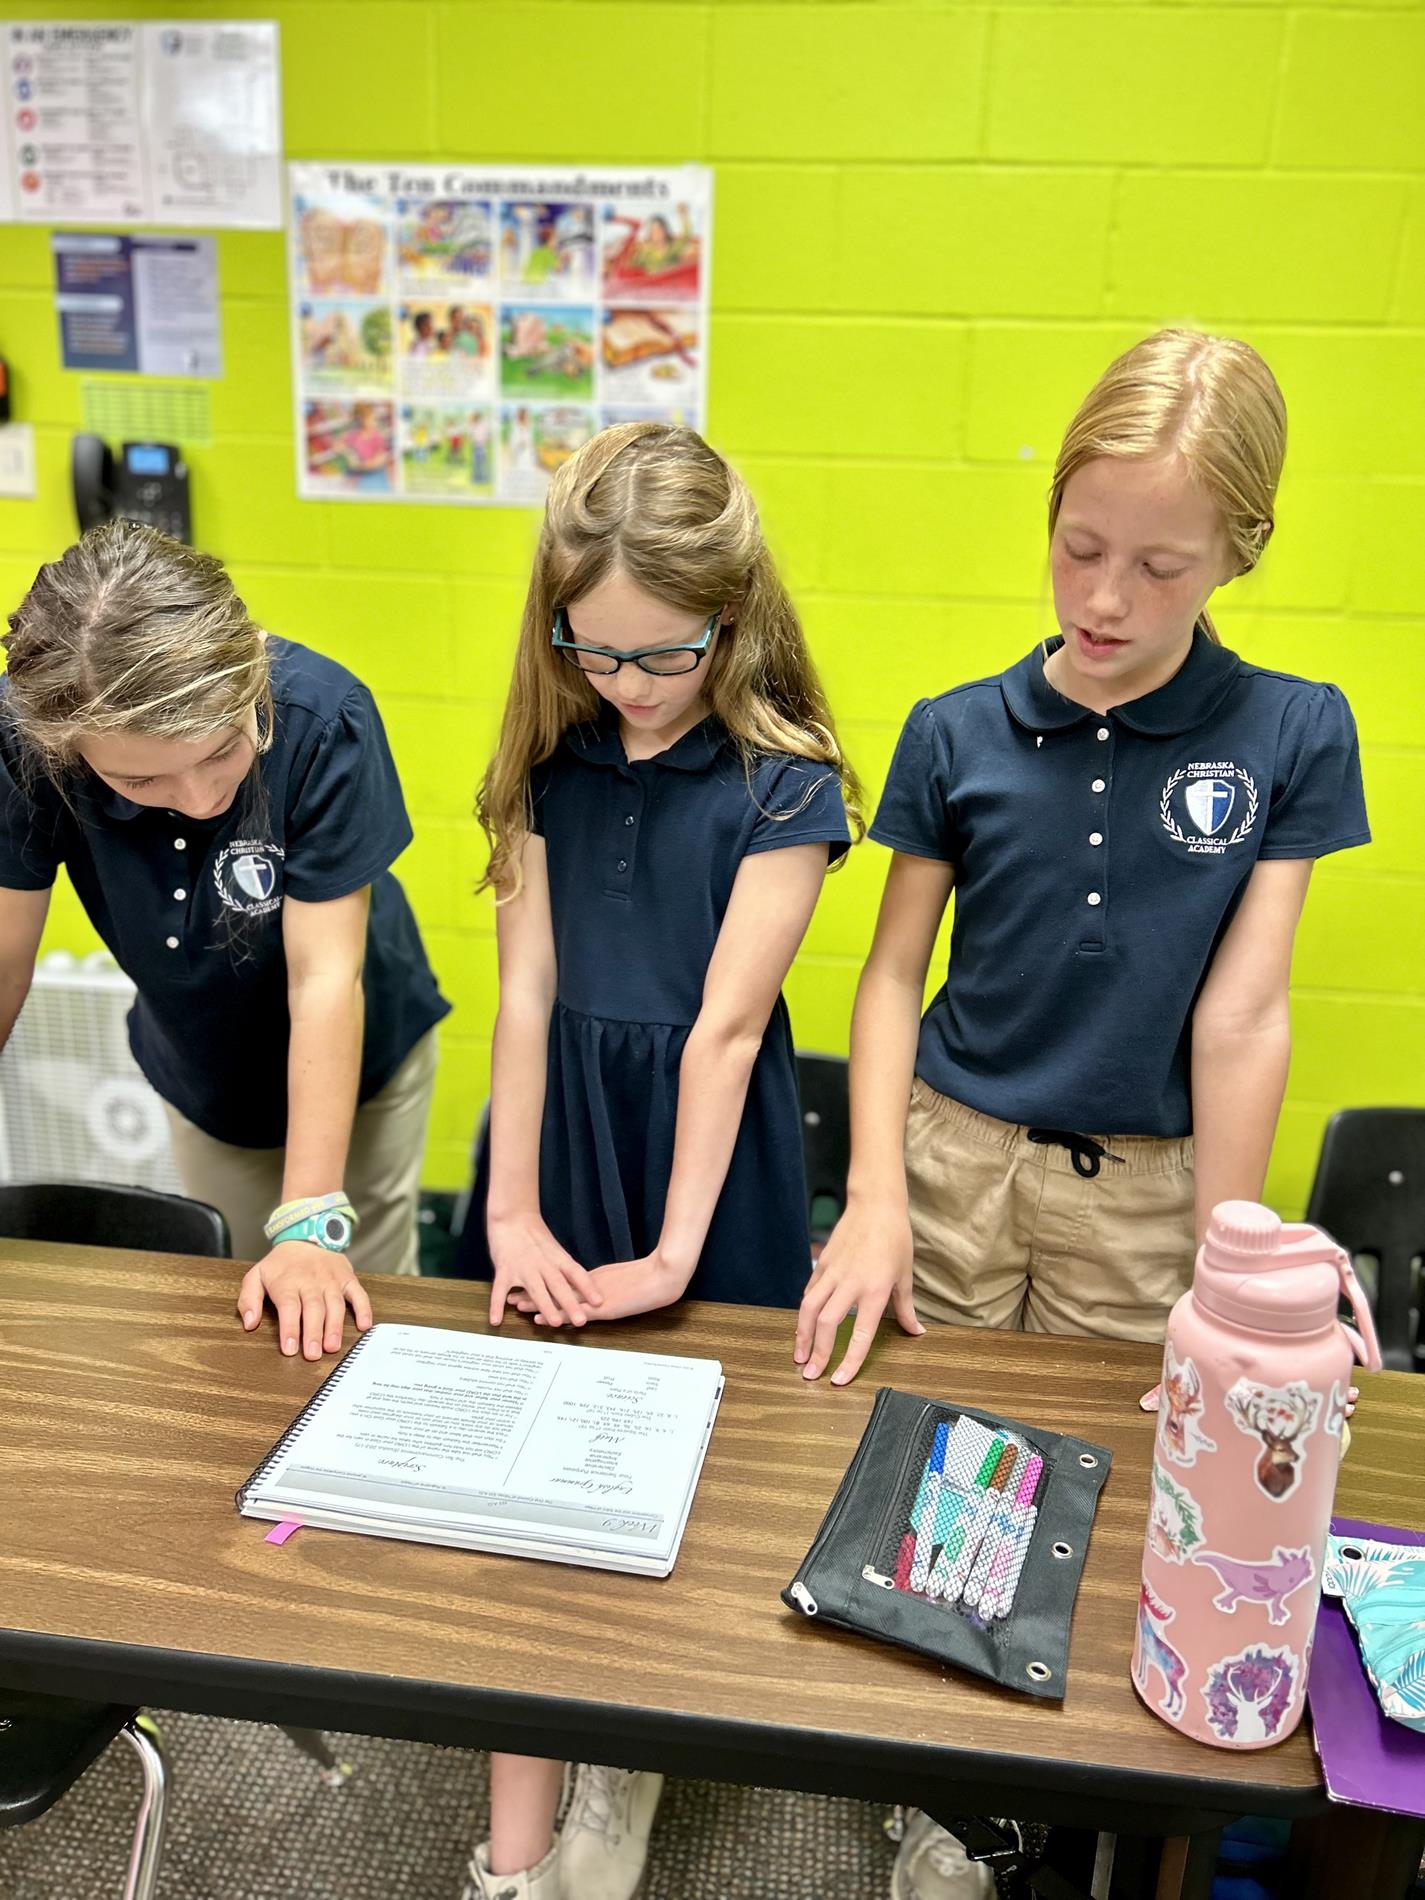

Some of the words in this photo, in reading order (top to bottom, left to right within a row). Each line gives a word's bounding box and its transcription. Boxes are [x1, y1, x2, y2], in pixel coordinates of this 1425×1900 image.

[328, 171, 374, 193] The
[387, 173, 436, 195] Ten
[443, 175, 670, 198] Commandments
[1188, 762, 1234, 770] NEBRASKA
[1187, 770, 1235, 778] CHRISTIAN
[1187, 836, 1228, 845] CLASSICAL
[1188, 845, 1226, 854] ACADEMY
[246, 896, 282, 910] CLASSICAL
[250, 902, 280, 917] ACADEMY
[607, 1394, 643, 1404] Science
[589, 1433, 624, 1444] Math
[378, 1457, 426, 1472] Scripture
[550, 1478, 593, 1489] Grammar
[587, 1479, 632, 1495] English
[610, 1520, 657, 1533] Week
